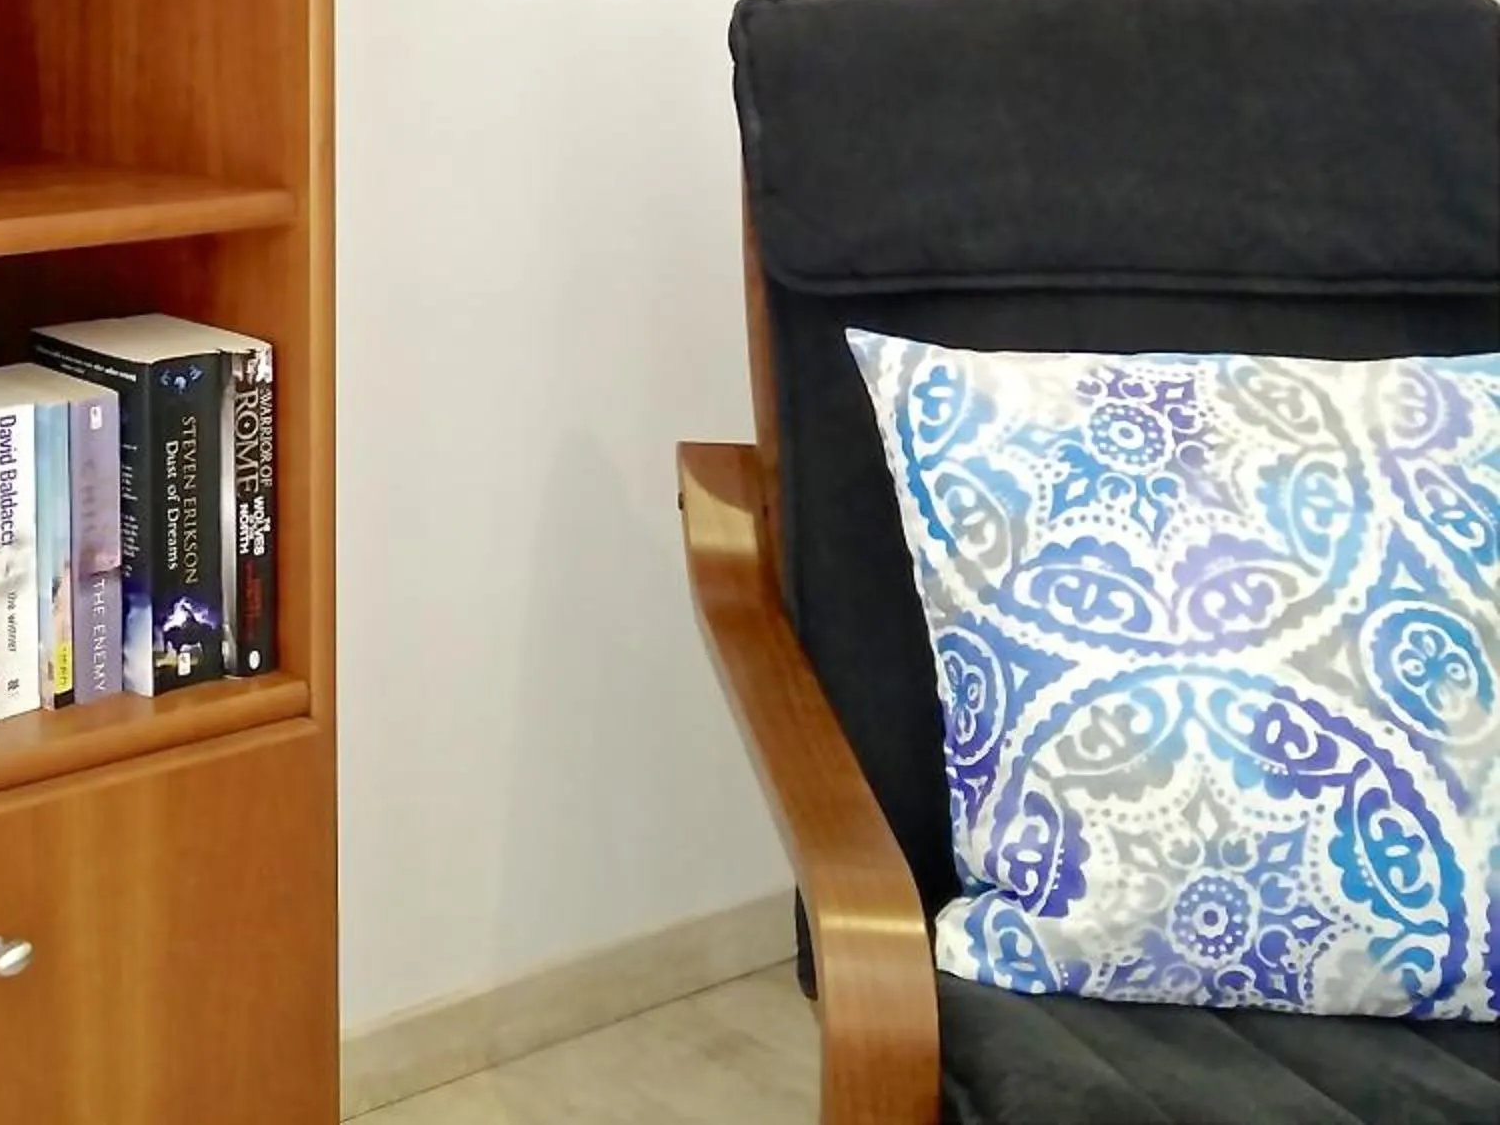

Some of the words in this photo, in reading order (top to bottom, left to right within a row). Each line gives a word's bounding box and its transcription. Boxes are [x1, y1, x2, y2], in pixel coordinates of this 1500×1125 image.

[181, 416, 198, 491] STEVEN
[235, 388, 259, 494] ROME
[260, 387, 273, 463] WARRIOR
[165, 440, 180, 478] Dust
[260, 465, 273, 487] OF
[0, 469, 19, 546] Baldacci
[167, 484, 181, 502] of
[167, 507, 181, 571] Dreams
[183, 496, 199, 584] ERIKSON
[239, 503, 250, 555] NORTH
[253, 496, 265, 556] WOLVES
[92, 578, 106, 617] THE
[93, 622, 108, 692] ENEMY
